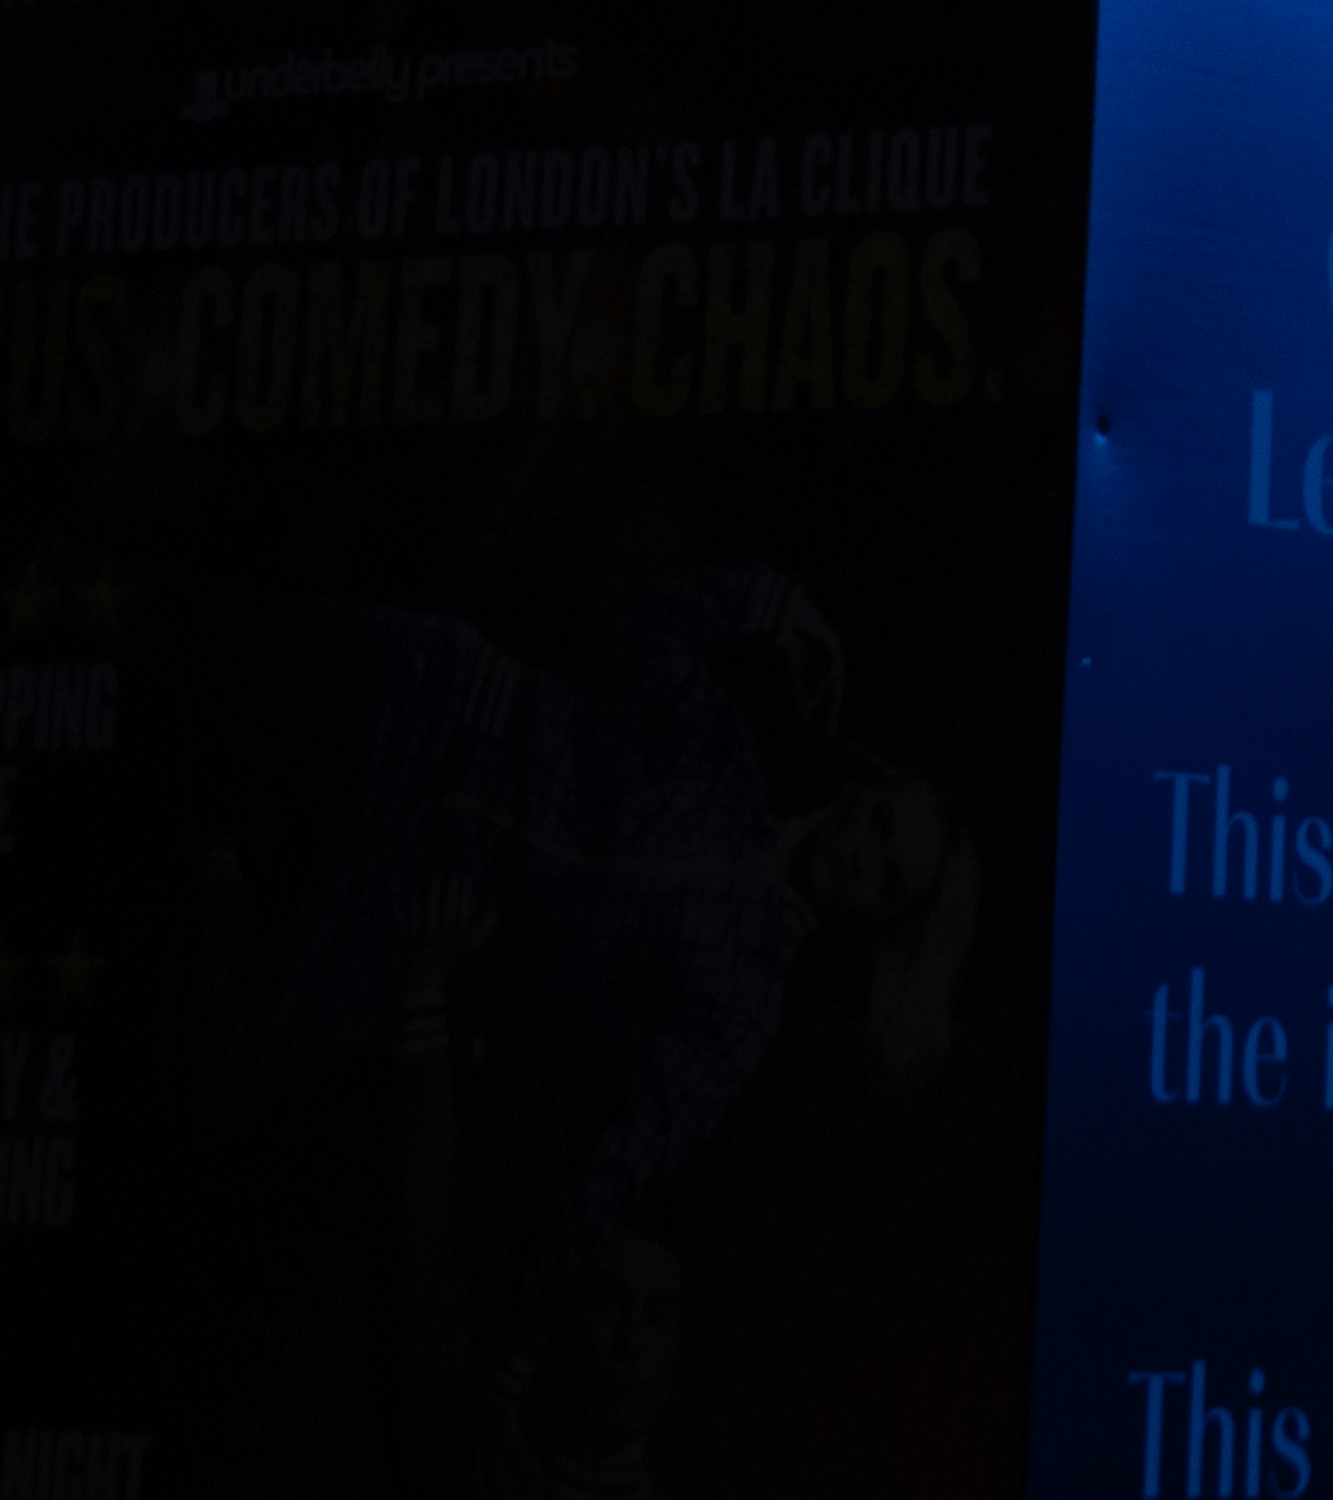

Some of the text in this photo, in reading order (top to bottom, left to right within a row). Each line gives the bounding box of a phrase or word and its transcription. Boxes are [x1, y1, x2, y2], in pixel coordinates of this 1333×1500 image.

[417, 36, 579, 101] presents
[56, 160, 341, 258] PRODUCERS
[357, 154, 422, 240] OF
[436, 138, 701, 236] LONDON'S
[720, 137, 781, 223] LA
[800, 122, 994, 214] CLIQUE
[632, 228, 1004, 421] CHAOS.
[1154, 762, 1333, 907] This
[1148, 965, 1288, 1108] the
[1127, 1359, 1313, 1500] This
